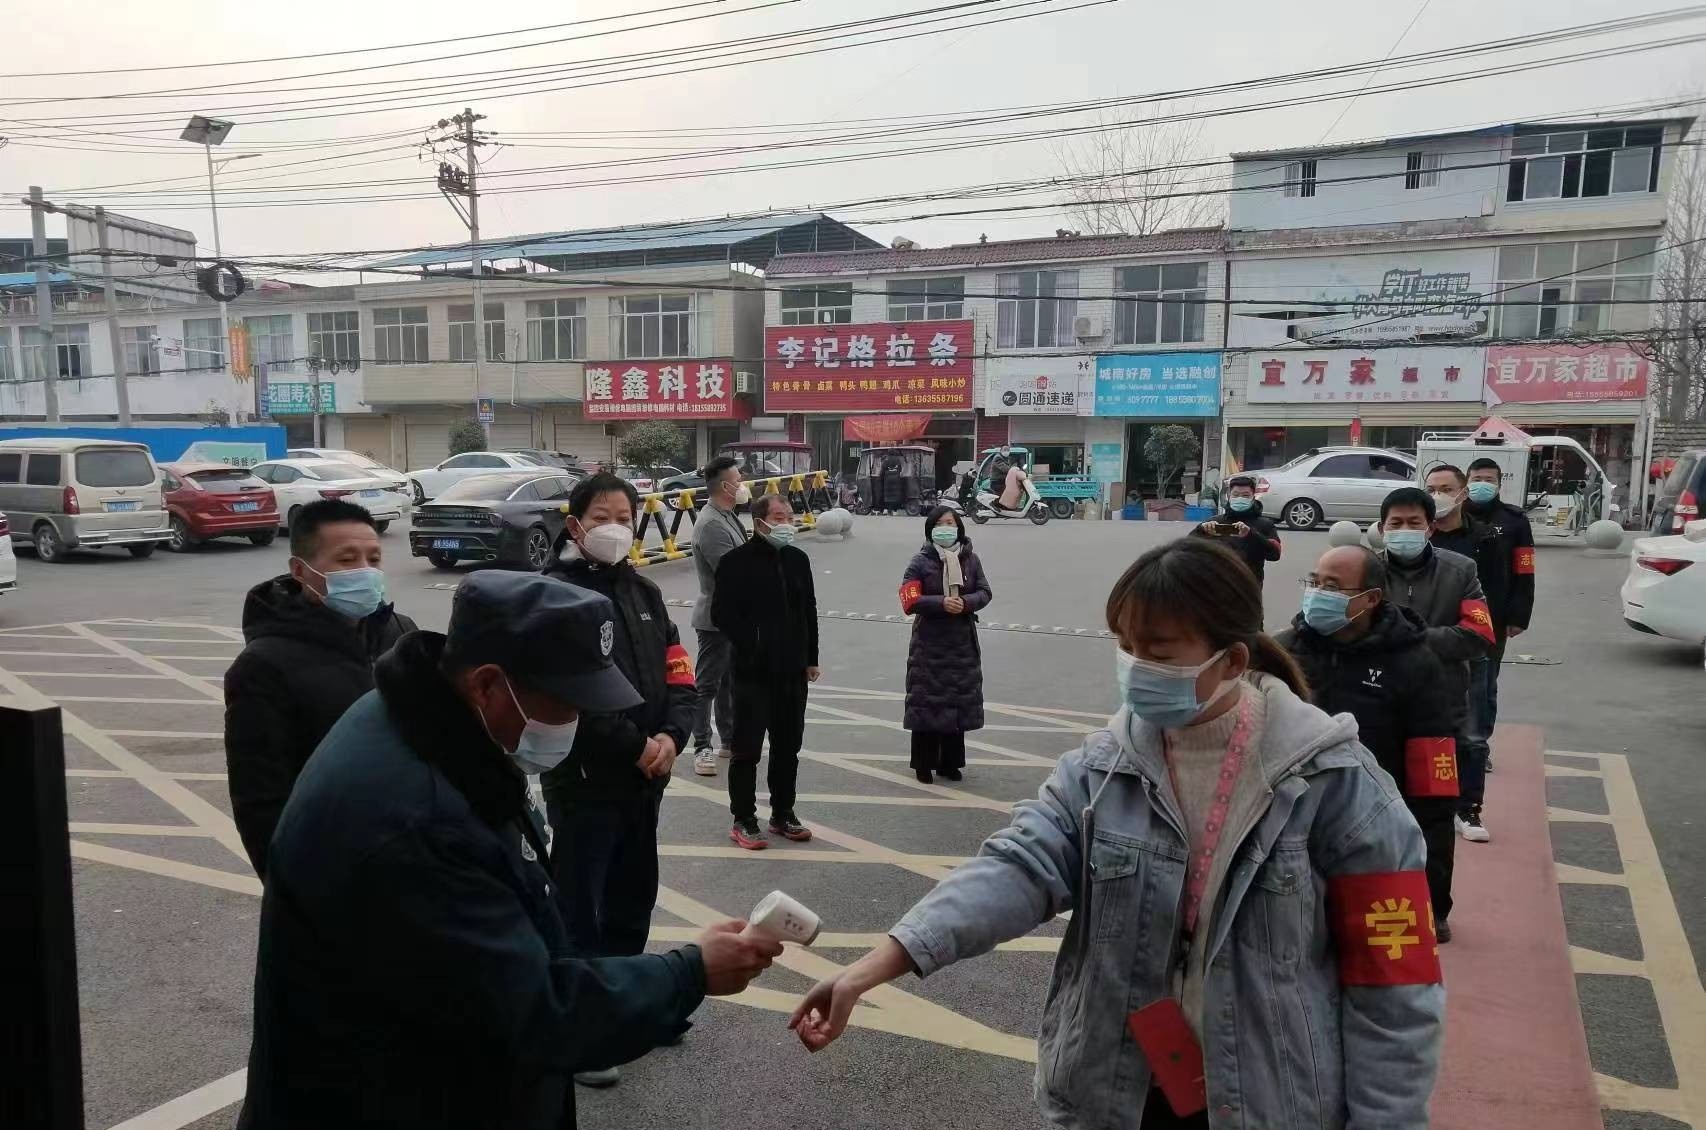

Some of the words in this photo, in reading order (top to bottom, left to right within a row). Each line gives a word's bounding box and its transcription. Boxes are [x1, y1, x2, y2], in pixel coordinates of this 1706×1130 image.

[777, 332, 960, 368] 李记格拉条
[585, 364, 726, 401] 隆鑫科技
[1099, 367, 1152, 381] 城南好房
[1162, 366, 1217, 380] 当选融创
[1259, 357, 1461, 385] 宜万家超市
[1495, 354, 1643, 384] 宜万家超市
[930, 378, 966, 389] 风味小炒
[1019, 392, 1074, 405] 圆通速递
[1433, 753, 1458, 780] 志
[1366, 897, 1439, 960] 学
